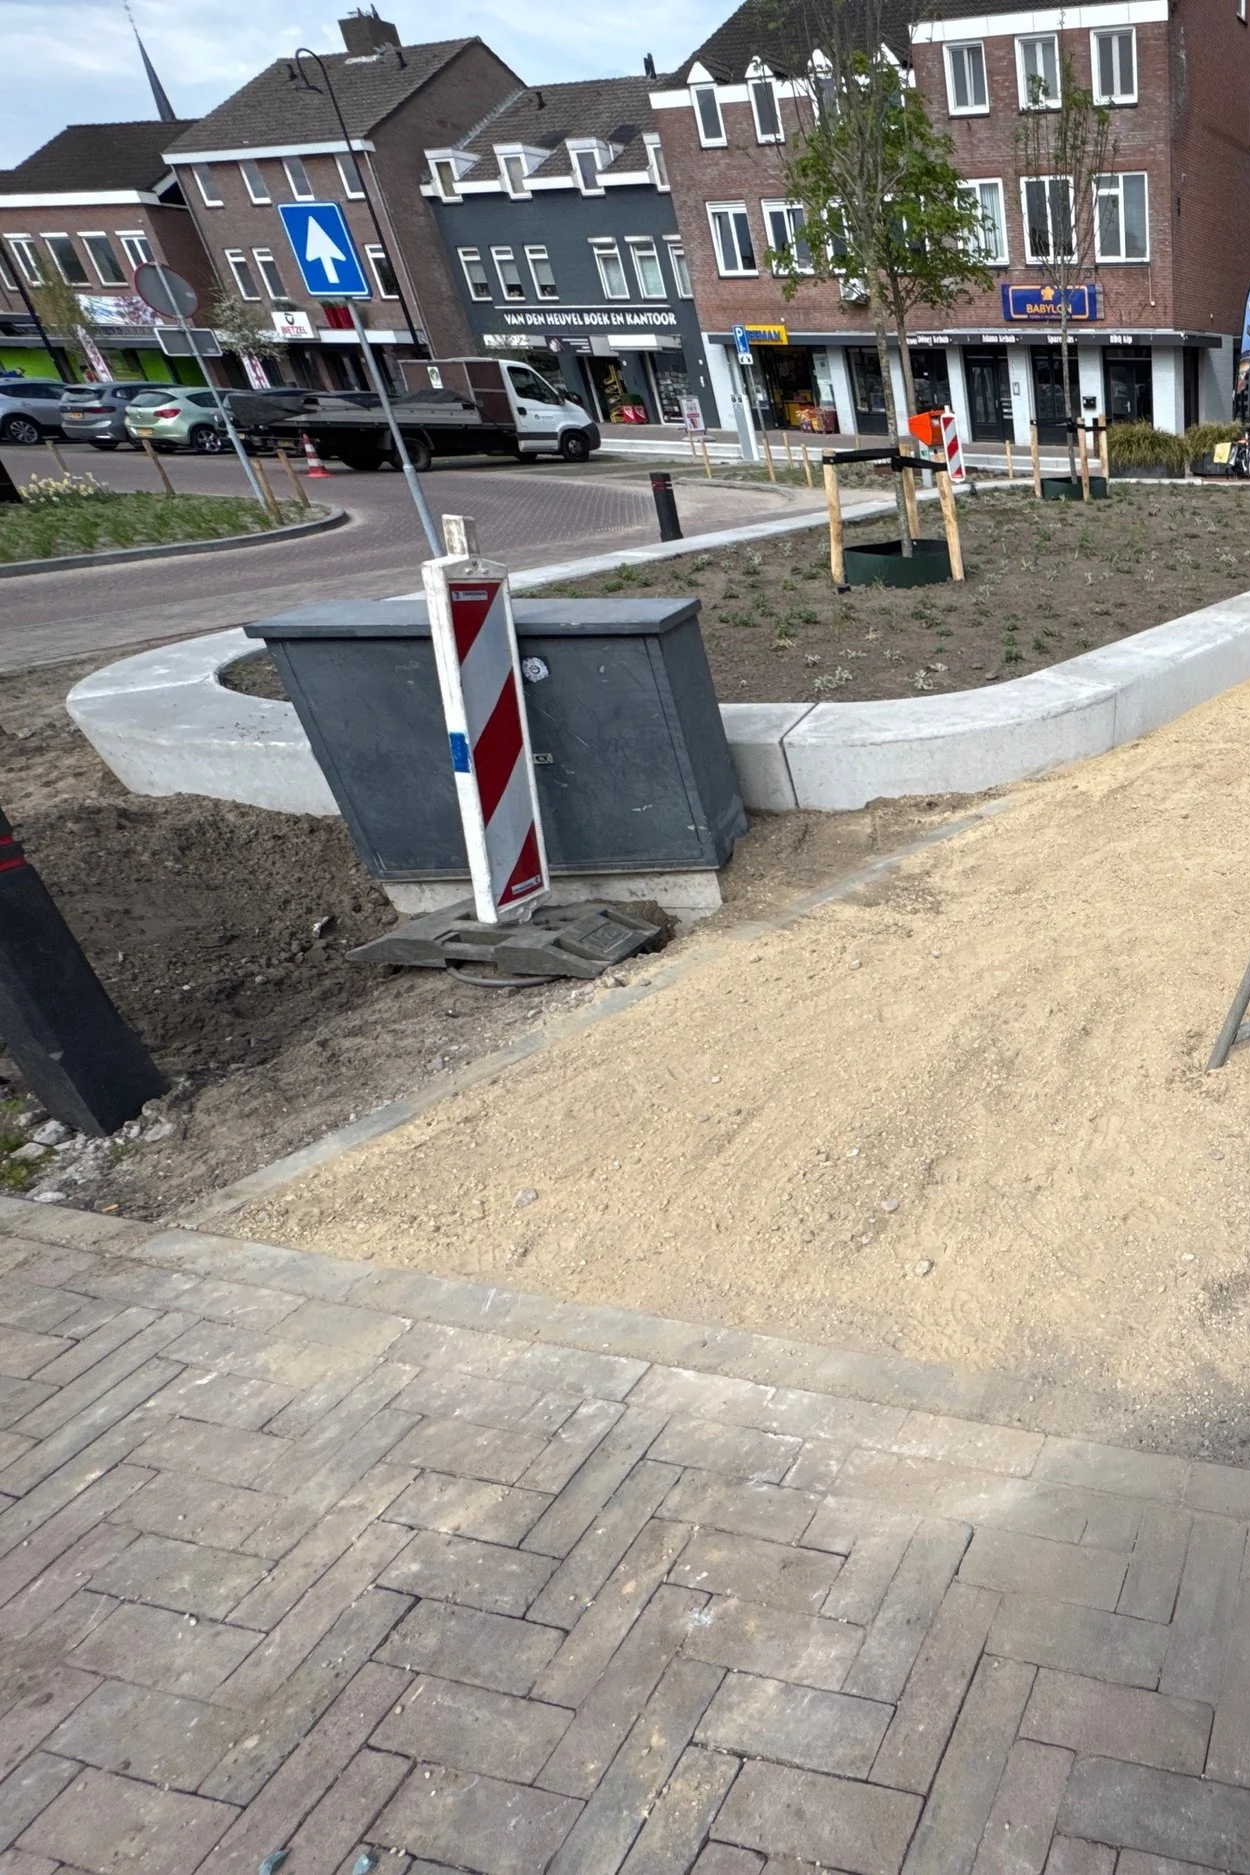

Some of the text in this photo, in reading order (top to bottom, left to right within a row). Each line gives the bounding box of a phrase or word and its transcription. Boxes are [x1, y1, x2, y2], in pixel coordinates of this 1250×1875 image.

[504, 312, 677, 326] VAN DEN HEUVEL BOEK EN KANTOOR
[735, 327, 743, 341] P
[745, 330, 780, 341] EEMAN
[999, 335, 1015, 343] kebab
